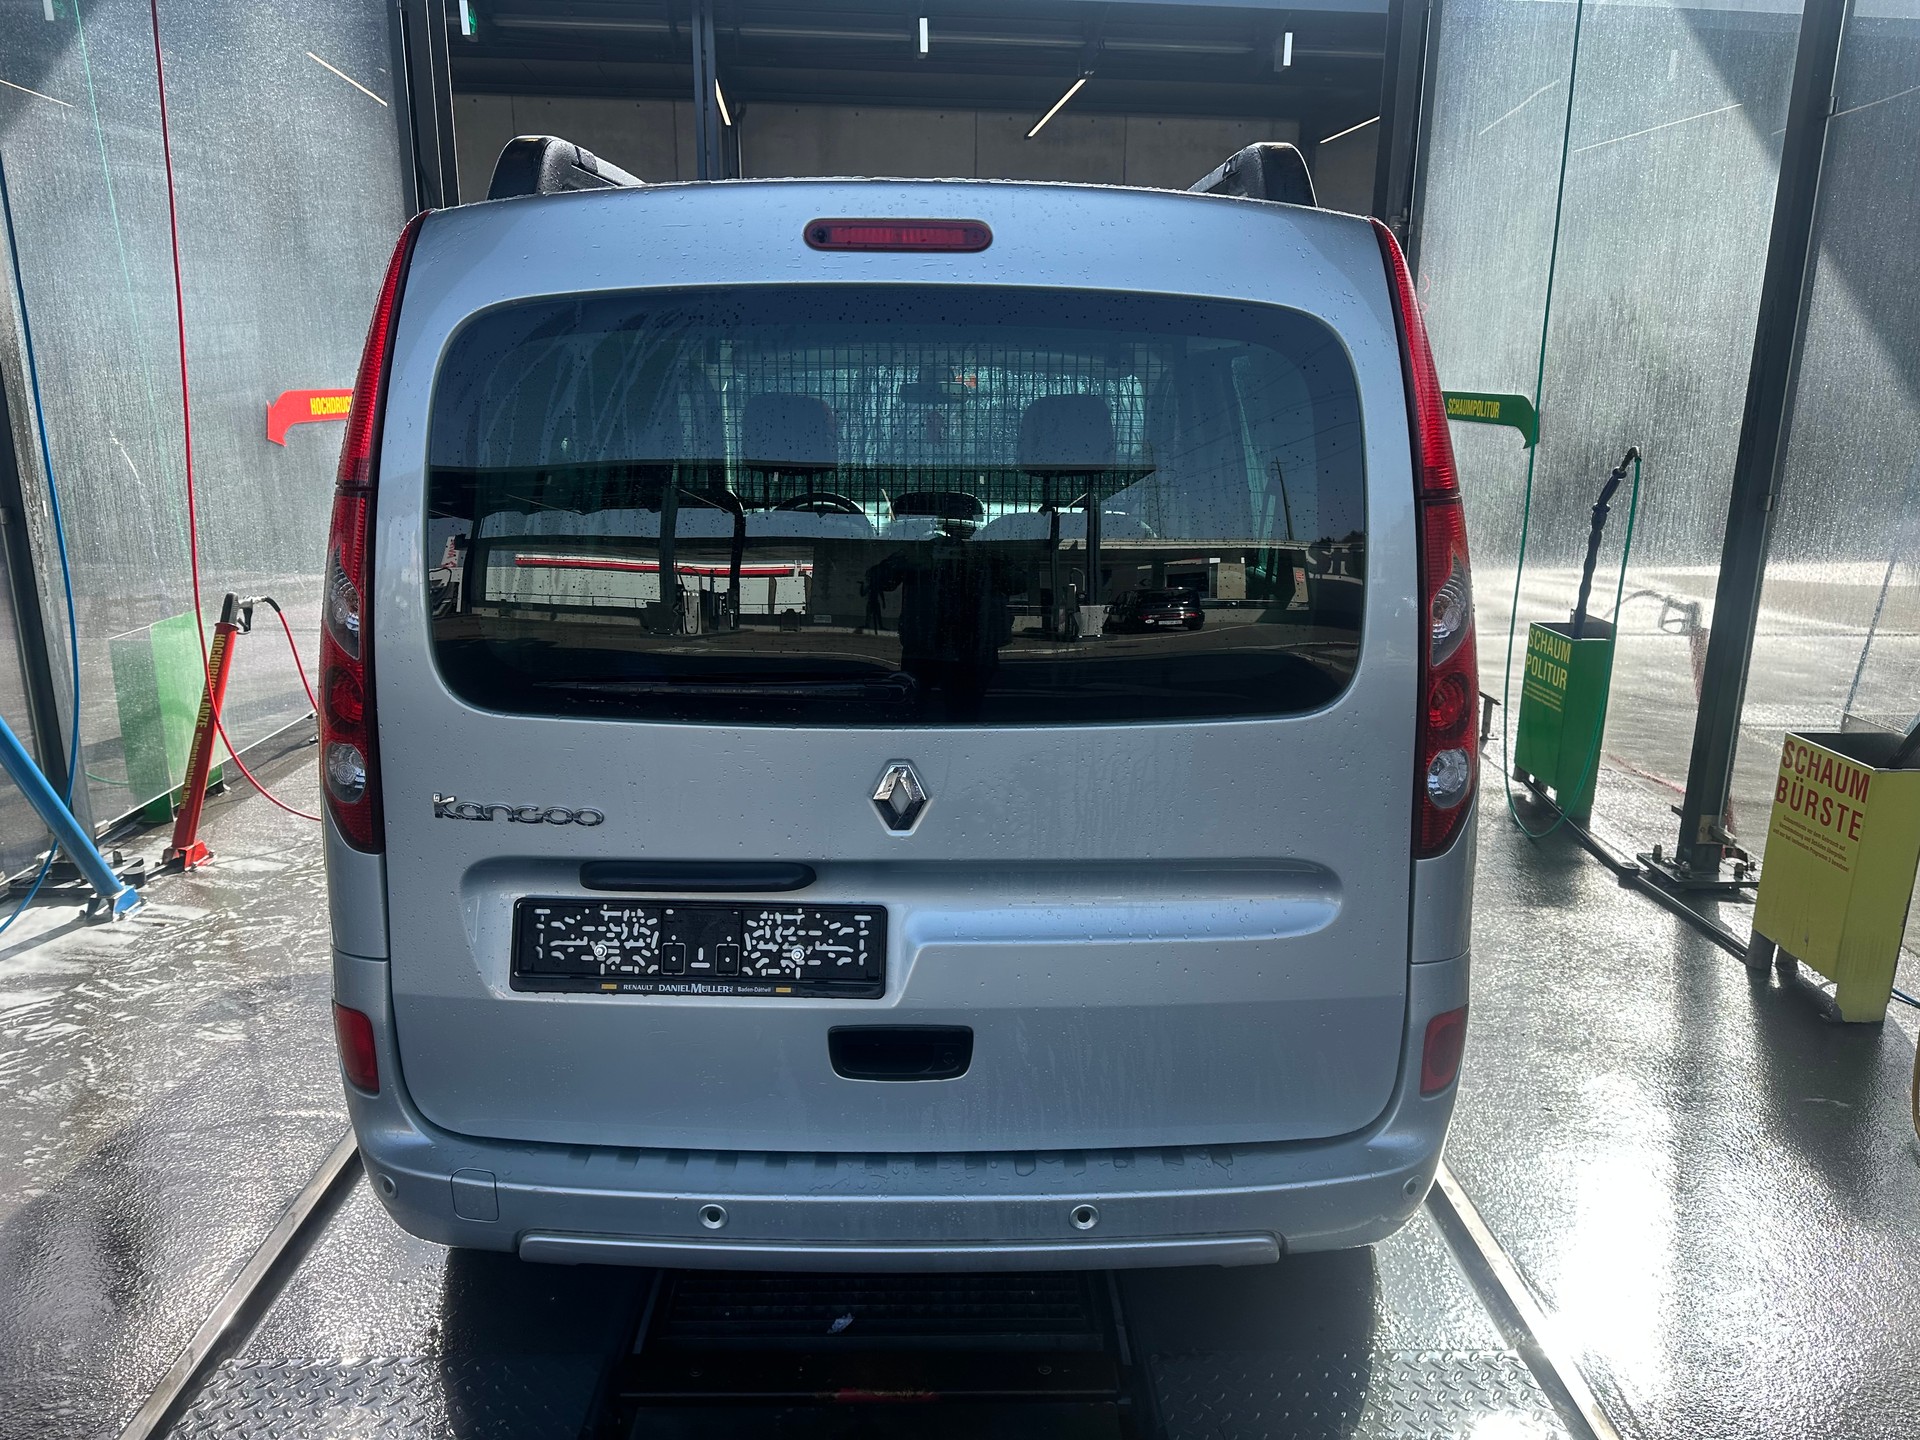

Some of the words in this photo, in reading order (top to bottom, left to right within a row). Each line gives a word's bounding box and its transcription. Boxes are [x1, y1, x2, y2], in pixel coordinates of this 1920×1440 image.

[310, 396, 352, 415] HOCHDRUC
[1447, 398, 1500, 419] SCHAUMPOLITUR
[1528, 628, 1571, 664] SCHAUM
[1525, 653, 1568, 690] POLITUR
[1782, 740, 1870, 804] SCHAUM
[1776, 775, 1863, 842] BÜRSTE
